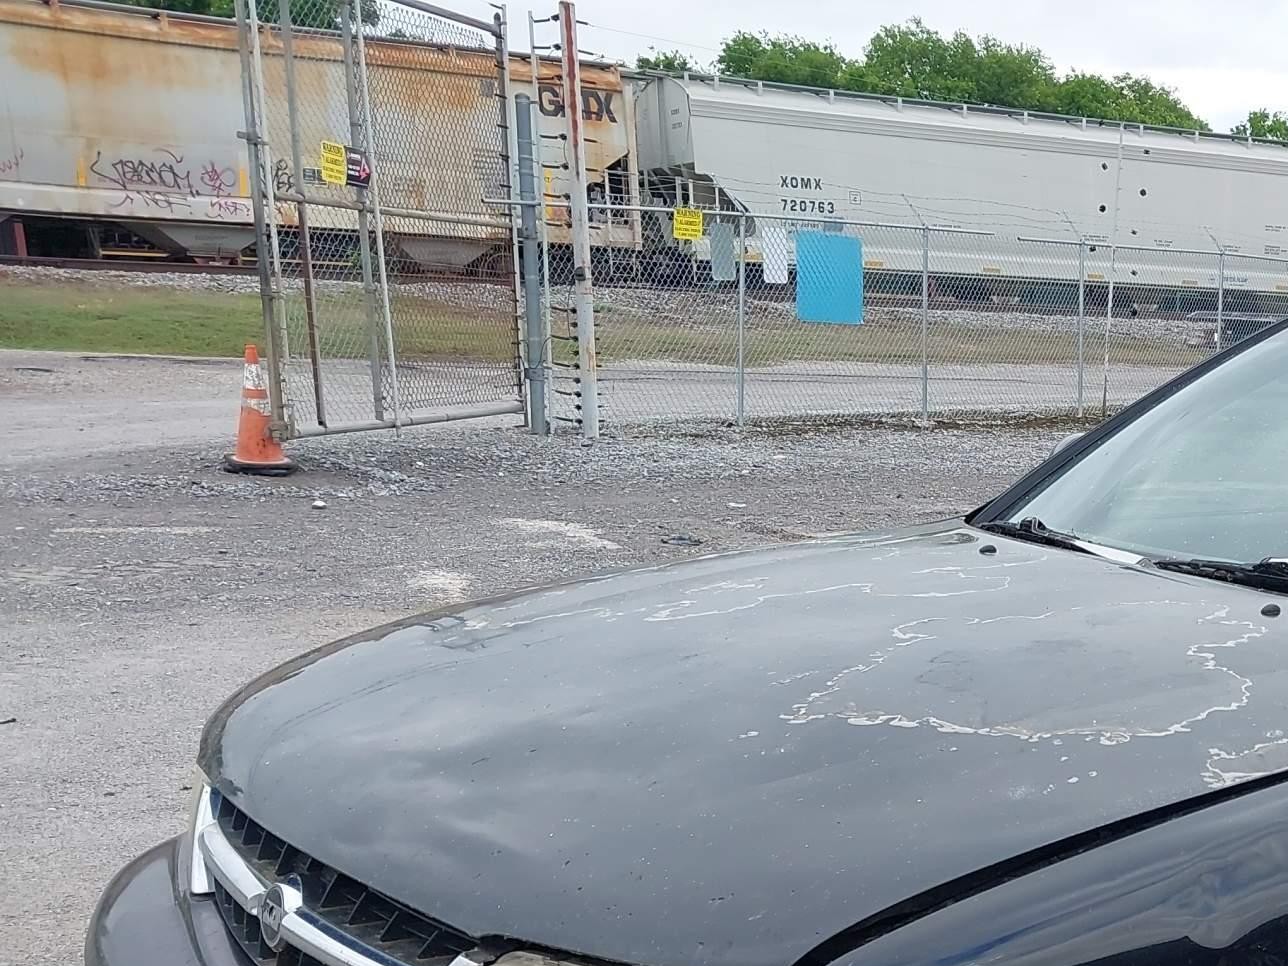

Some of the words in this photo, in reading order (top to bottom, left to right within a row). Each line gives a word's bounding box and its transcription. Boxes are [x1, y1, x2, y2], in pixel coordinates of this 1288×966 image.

[538, 85, 618, 124] GTX
[780, 175, 823, 190] XOMX
[780, 198, 835, 214] 720763
